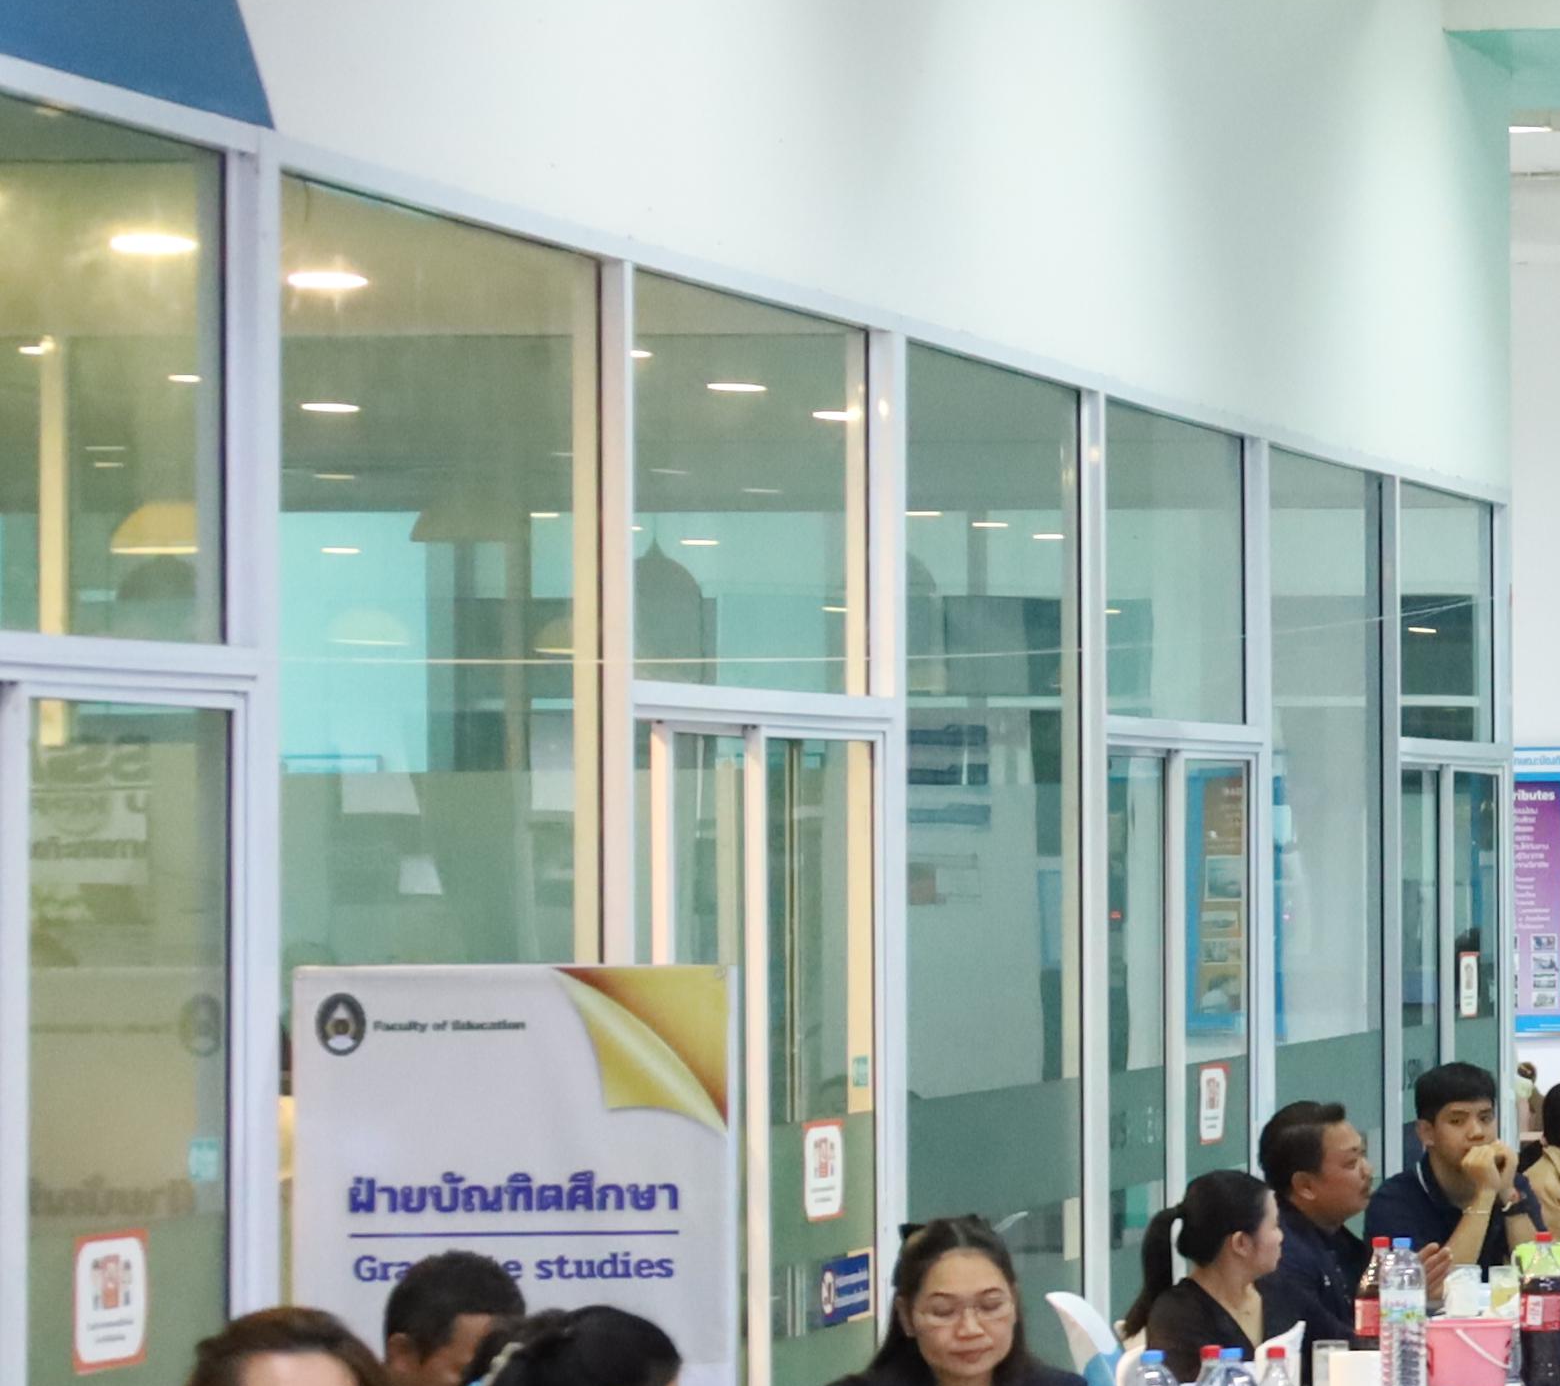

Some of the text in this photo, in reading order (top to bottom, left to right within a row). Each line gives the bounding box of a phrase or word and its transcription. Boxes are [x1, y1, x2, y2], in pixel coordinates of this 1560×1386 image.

[1512, 789, 1556, 801] ributes
[373, 1018, 526, 1033] Faculty of Education
[347, 1170, 680, 1214] ฝ่ายบัณฑิตศึกษา
[353, 1252, 674, 1282] Grae studies
